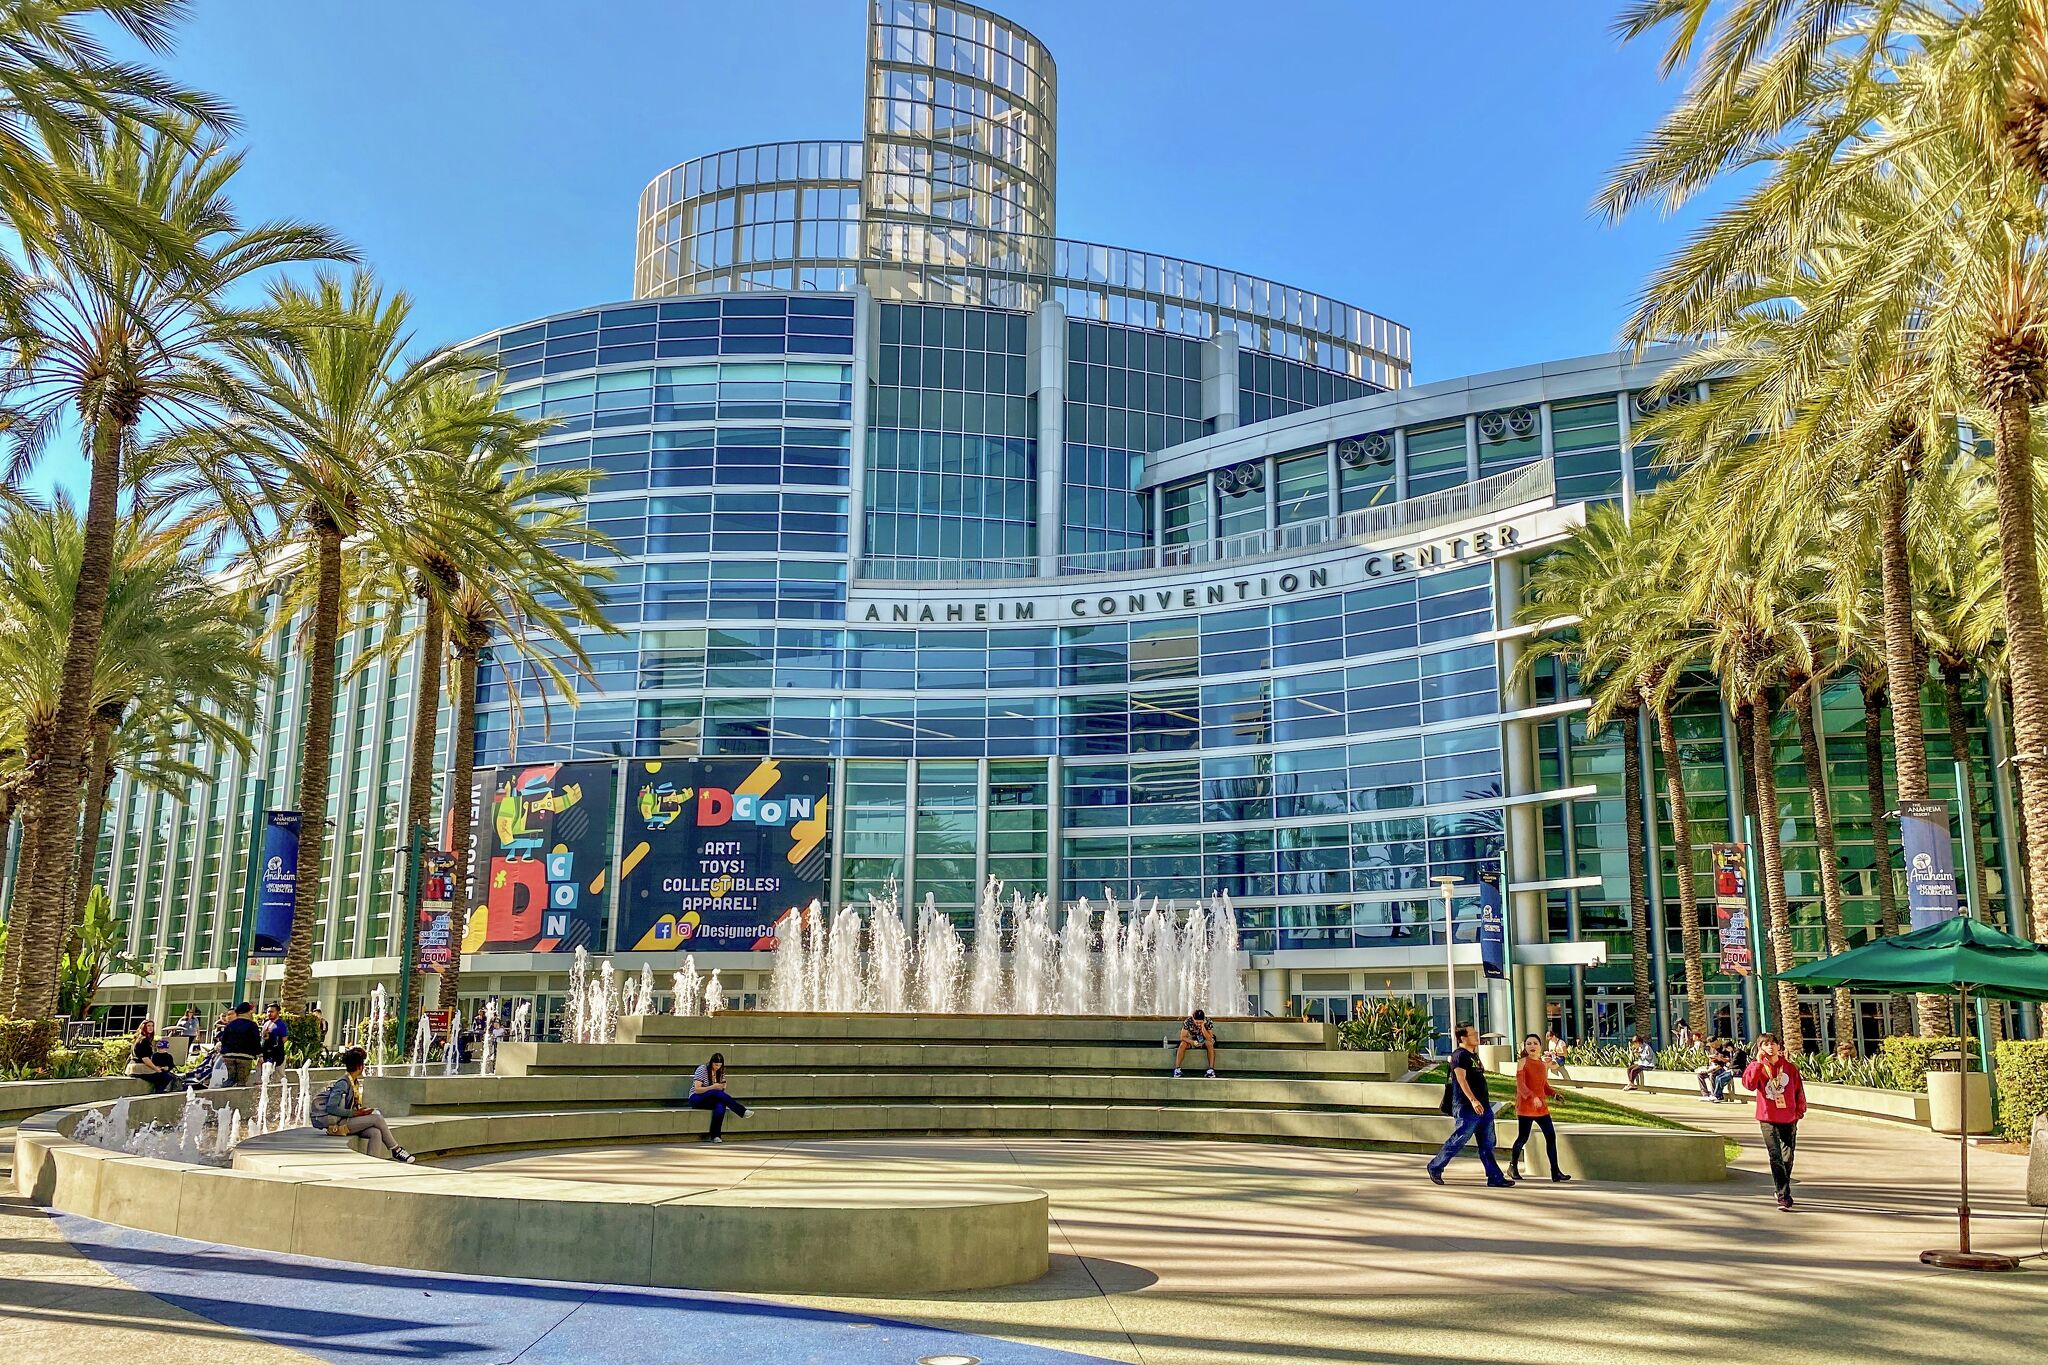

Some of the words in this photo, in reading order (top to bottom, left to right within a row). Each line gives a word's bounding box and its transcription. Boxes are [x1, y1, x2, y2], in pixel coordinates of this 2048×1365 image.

[865, 601, 1034, 622] ANAHEIM
[1070, 567, 1327, 617] CONVENTION
[1364, 524, 1513, 577] CENTER
[704, 841, 741, 855] ART!
[699, 859, 745, 874] TOYS!
[1910, 866, 1954, 882] Anaheim
[262, 867, 296, 882] Anaheim
[662, 877, 780, 892] COLLECTIBLES!
[485, 856, 549, 942] D
[682, 897, 758, 911] APPAREL!
[695, 924, 775, 939] /DesignerCo
[421, 953, 447, 962] .COM
[1724, 953, 1748, 963] .COM
